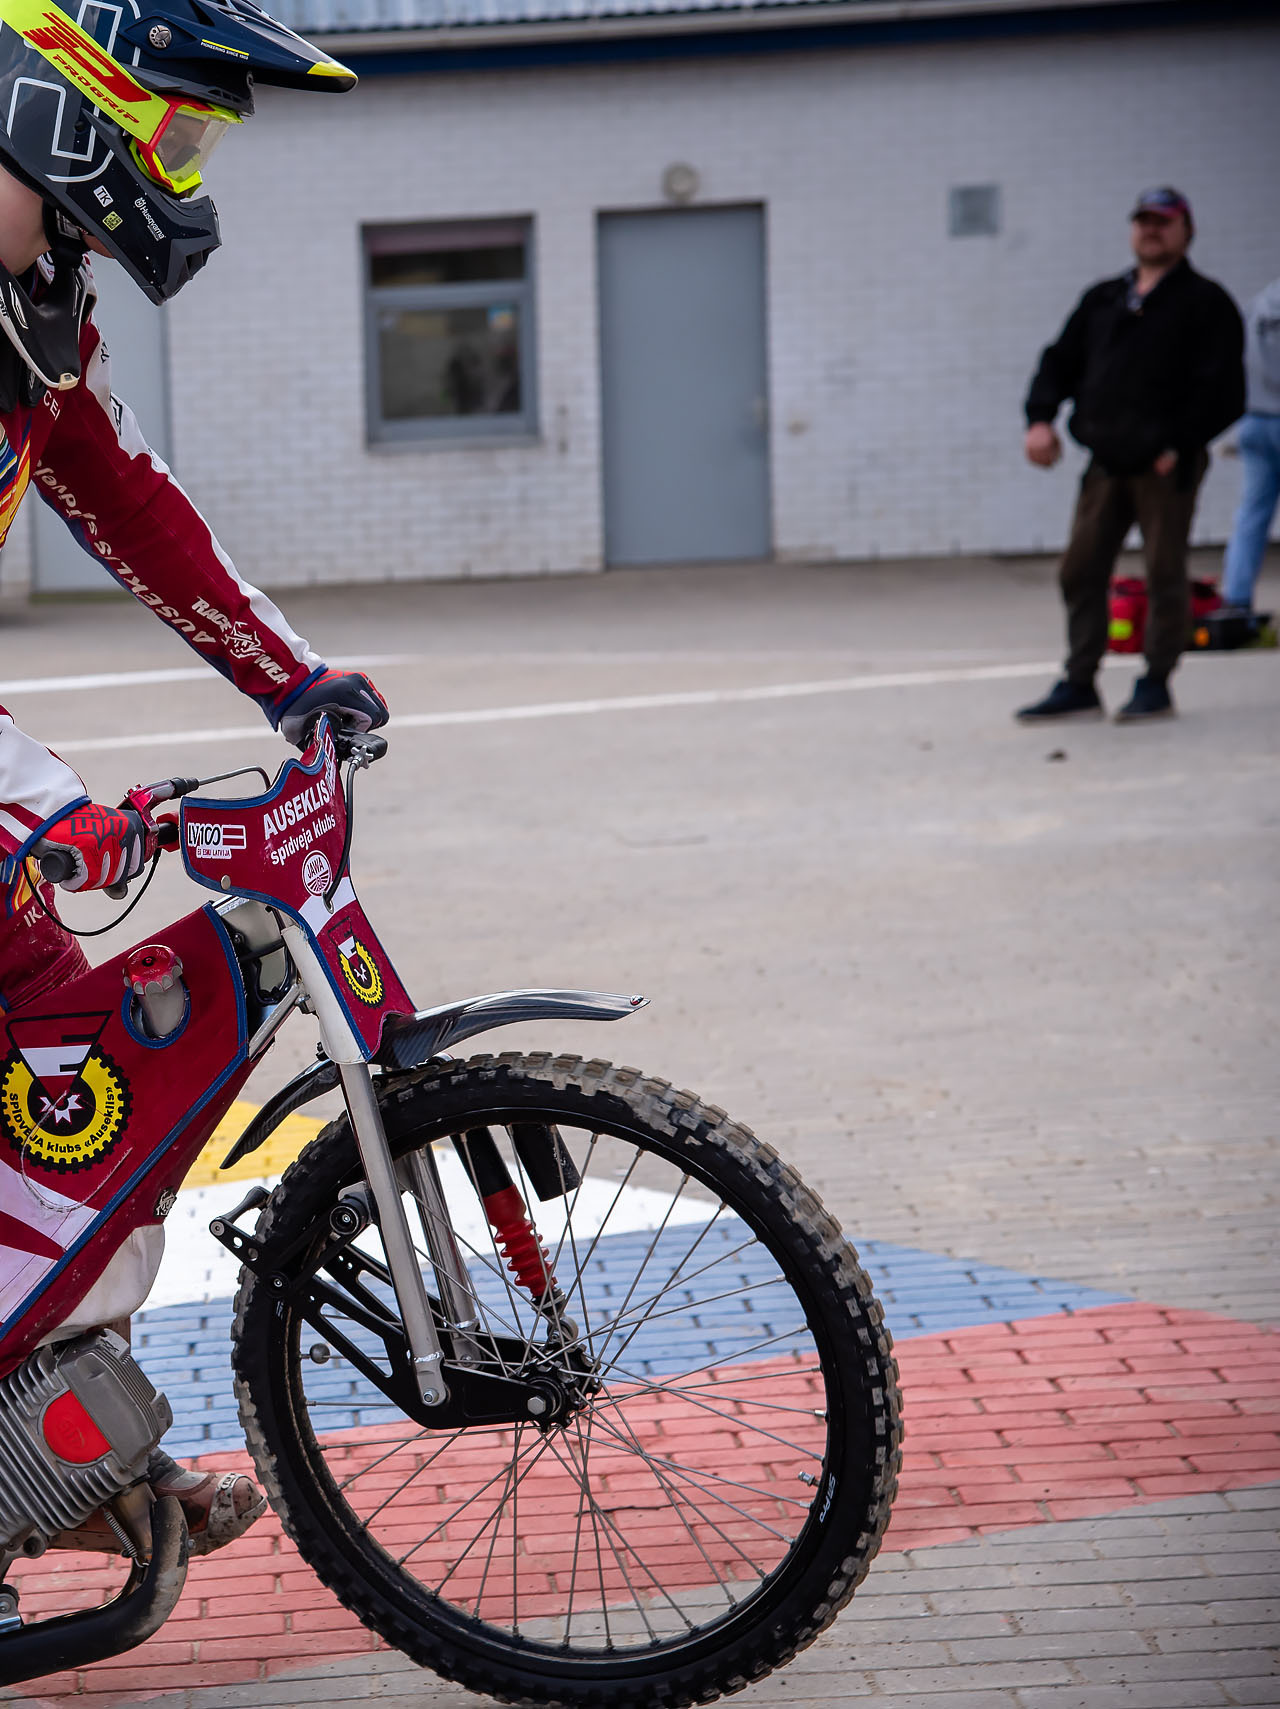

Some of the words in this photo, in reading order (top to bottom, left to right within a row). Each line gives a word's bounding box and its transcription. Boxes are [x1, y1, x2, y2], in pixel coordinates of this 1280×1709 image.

[52, 54, 140, 123] PROGRIP
[97, 188, 112, 205] TK
[140, 206, 166, 239] Husqvarna
[263, 779, 330, 840] AUSEKLIS
[312, 813, 336, 838] klubs
[307, 856, 324, 878] JAWA
[24, 906, 44, 928] IK
[46, 1140, 82, 1154] klubs
